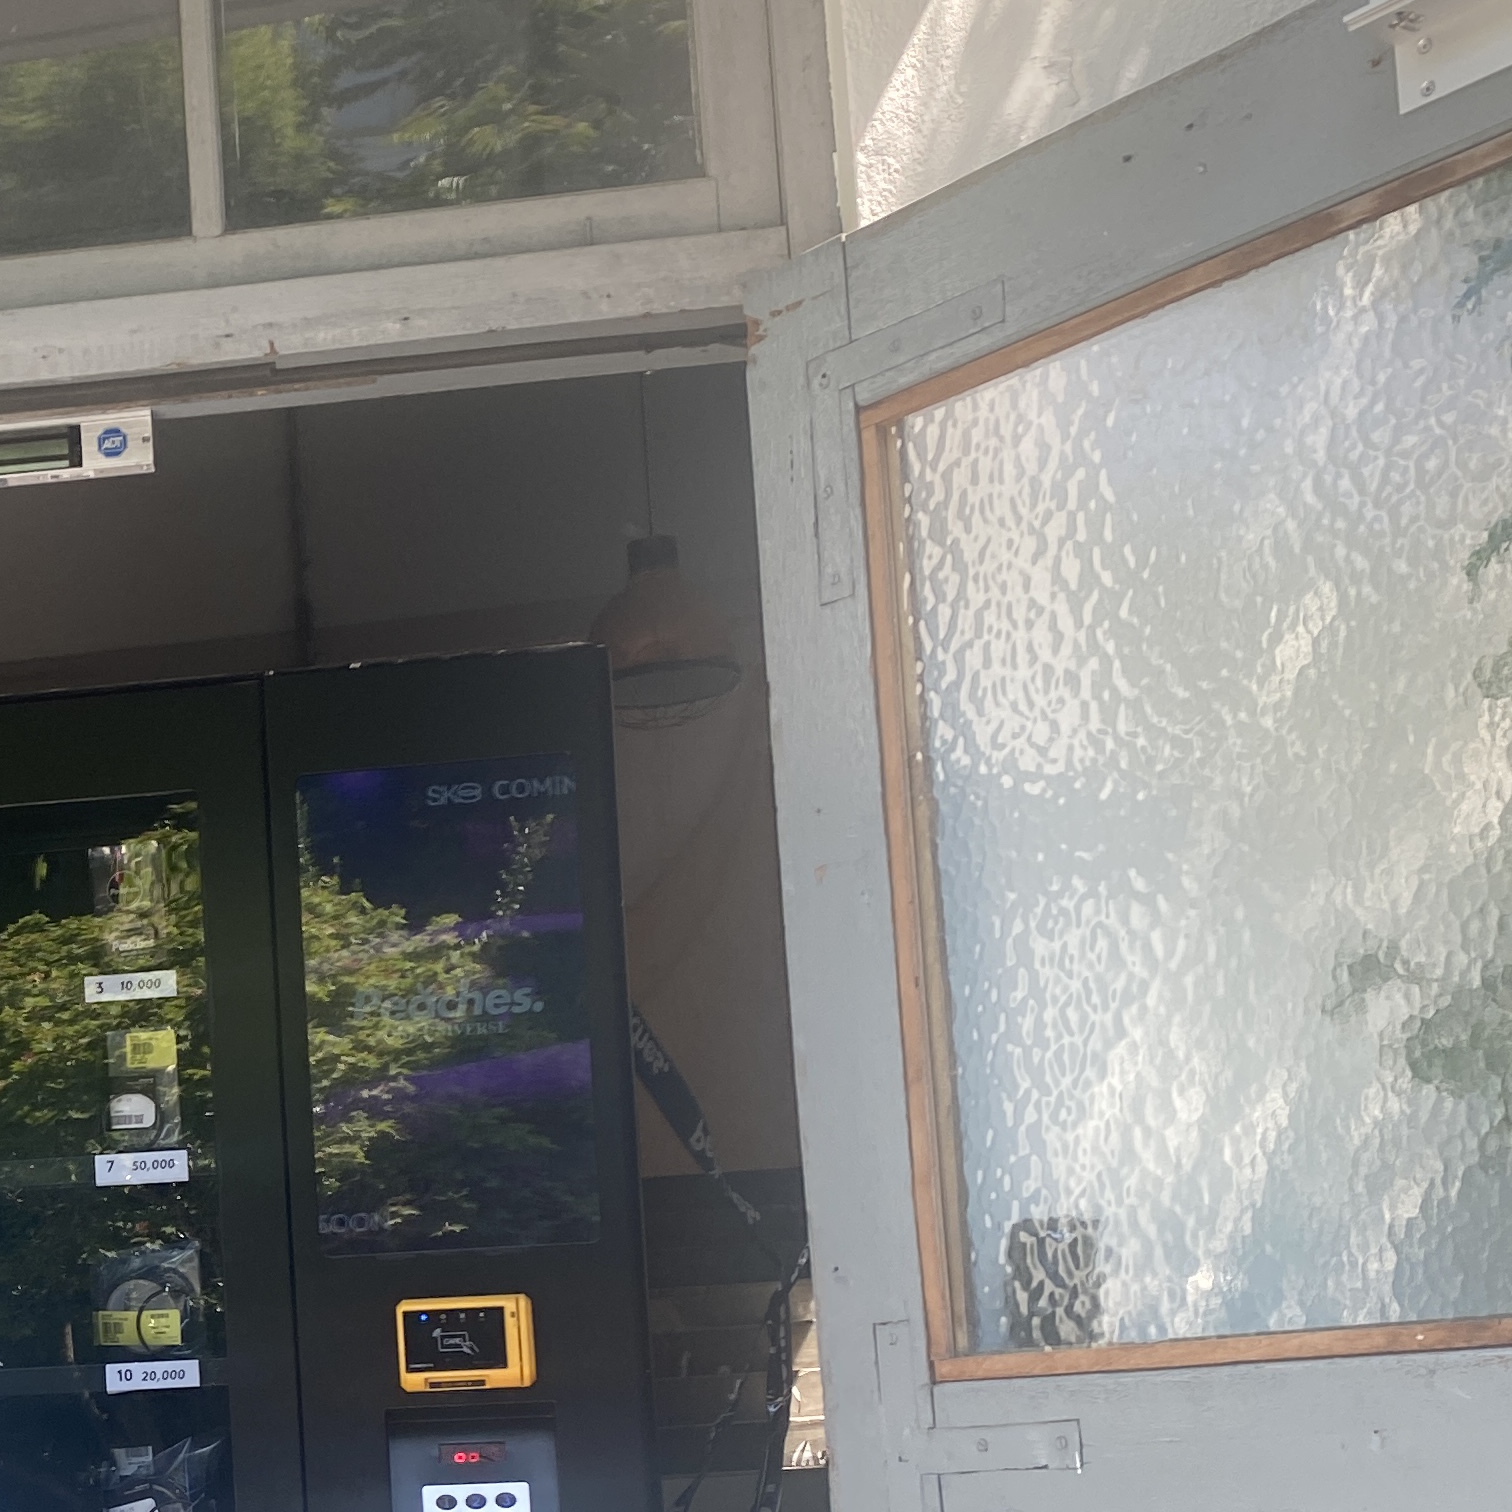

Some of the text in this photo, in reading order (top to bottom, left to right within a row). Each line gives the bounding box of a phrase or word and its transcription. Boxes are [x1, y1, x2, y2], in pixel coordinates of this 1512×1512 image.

[100, 436, 124, 450] ADT
[94, 978, 162, 995] 3 10,000
[105, 1158, 176, 1173] 7 50,000
[117, 1368, 186, 1383] 10 20,000
